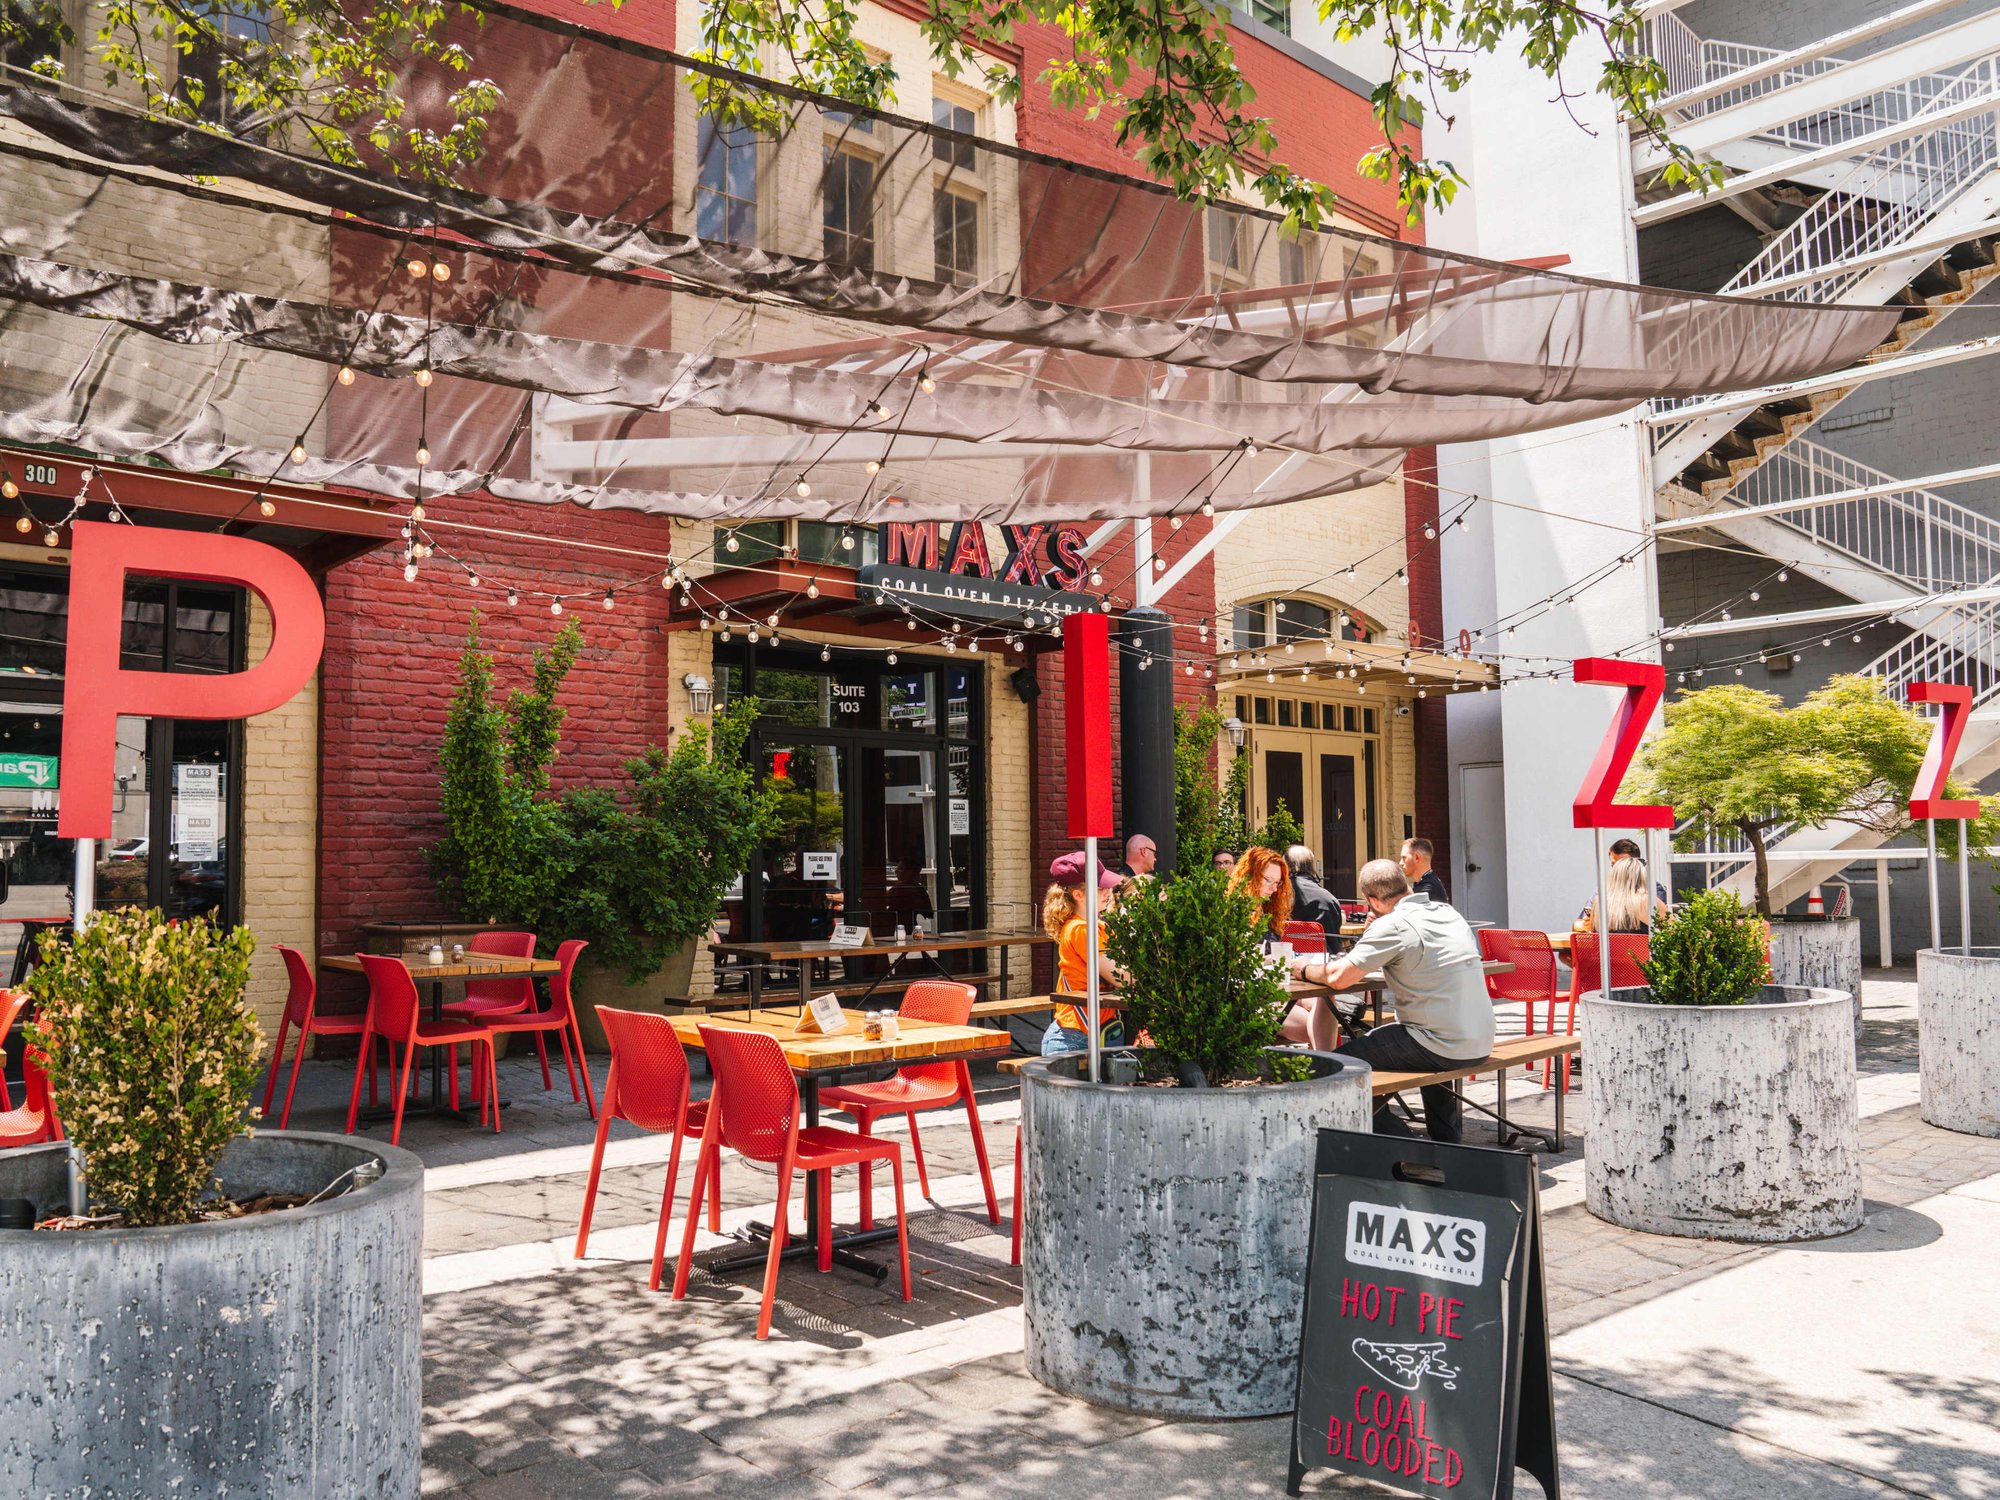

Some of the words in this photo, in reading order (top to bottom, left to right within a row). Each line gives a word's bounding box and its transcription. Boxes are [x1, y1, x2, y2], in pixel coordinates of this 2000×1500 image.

[25, 464, 57, 485] 300
[881, 577, 930, 594] COAL
[945, 586, 991, 605] OVEN
[1002, 596, 1094, 615] PIZZERIA
[58, 519, 326, 839] P
[1573, 656, 1675, 829] Z
[1907, 681, 1981, 820] Z
[832, 685, 865, 697] SUITE
[838, 701, 860, 713] 103
[1354, 1210, 1477, 1263] MAX'S
[1353, 1249, 1380, 1260] COAL
[1387, 1255, 1415, 1266] OVEN
[1422, 1261, 1475, 1278] PIZZERIA
[1340, 1276, 1405, 1327] HOT
[1418, 1291, 1465, 1340] PIE
[1355, 1385, 1432, 1441] COAL
[1327, 1415, 1463, 1488] BLOODED
